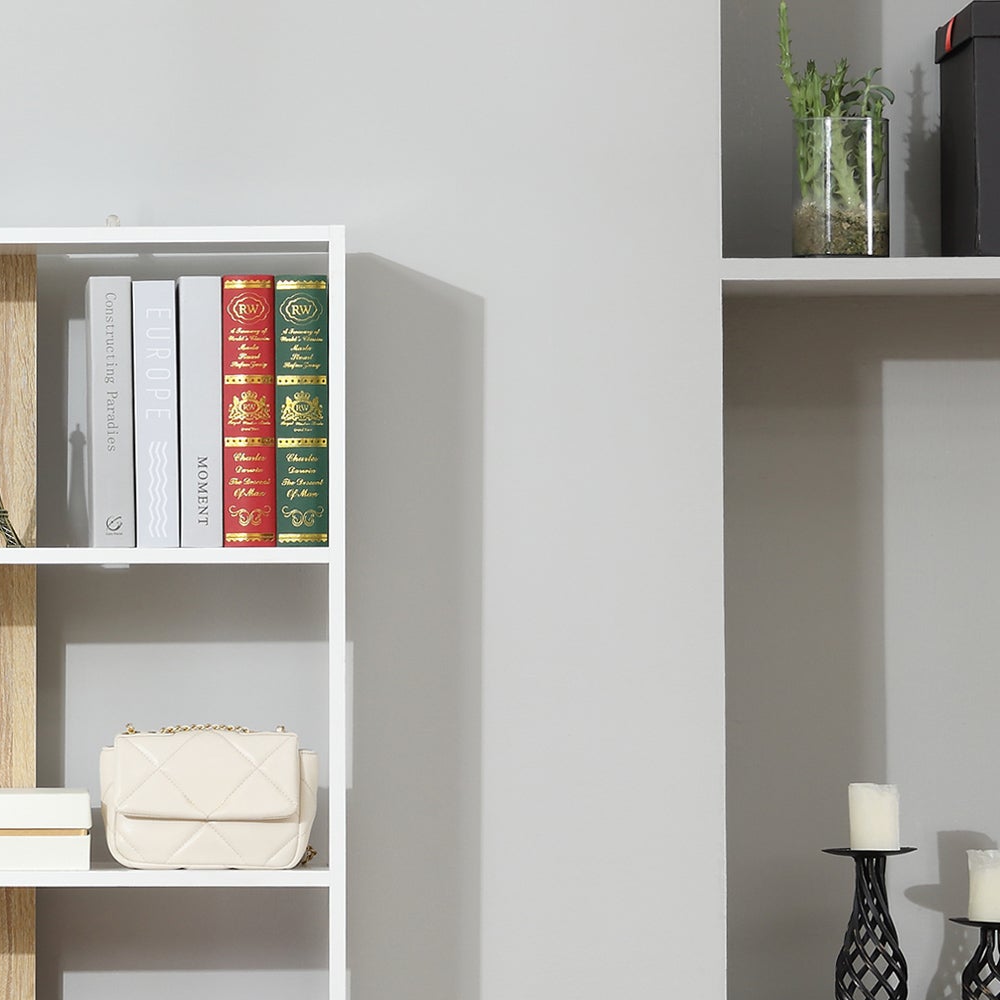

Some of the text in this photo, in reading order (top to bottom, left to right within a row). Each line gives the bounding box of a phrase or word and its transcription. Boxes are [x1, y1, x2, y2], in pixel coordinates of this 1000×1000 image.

[239, 303, 259, 315] RW
[291, 304, 312, 315] RW
[104, 292, 119, 452] Constructing Paradies
[145, 307, 172, 420] EUROPE
[197, 456, 209, 525] MOMENT
